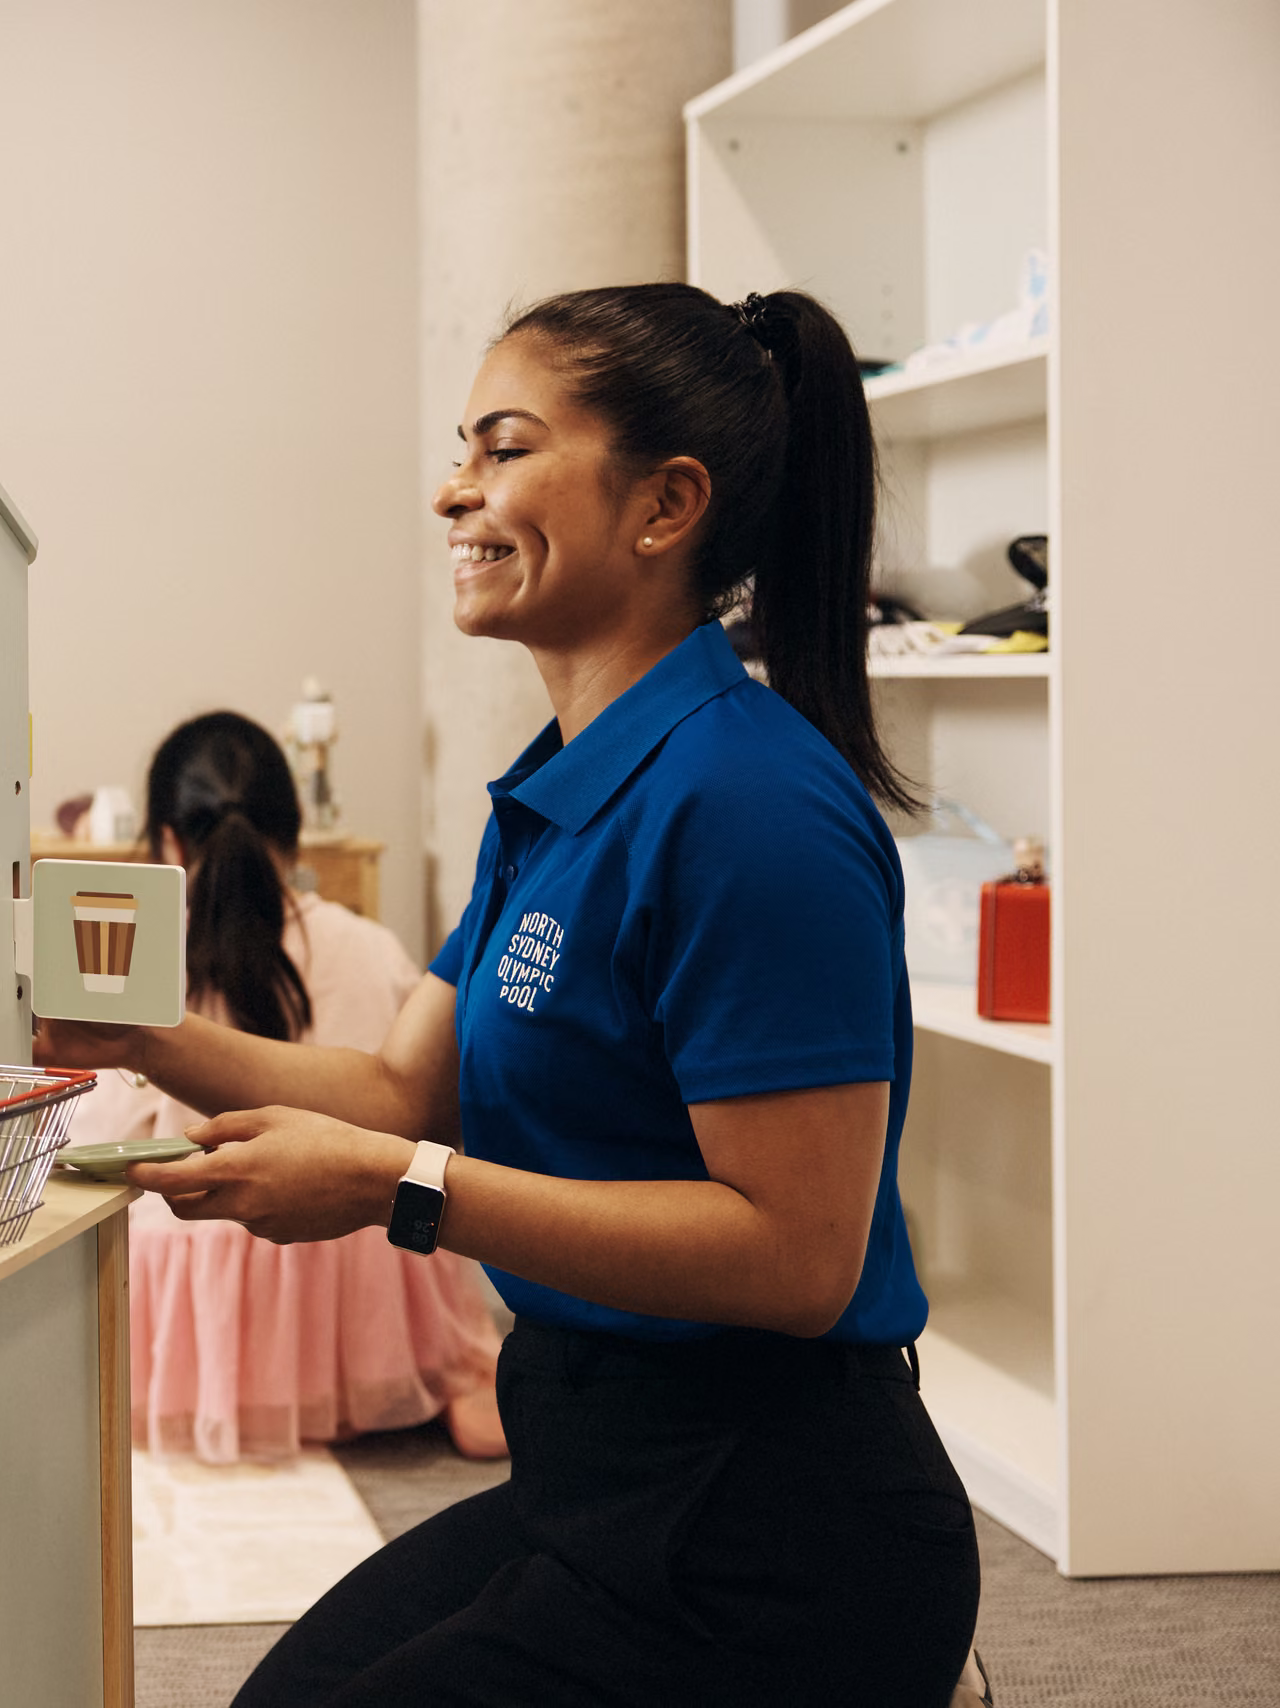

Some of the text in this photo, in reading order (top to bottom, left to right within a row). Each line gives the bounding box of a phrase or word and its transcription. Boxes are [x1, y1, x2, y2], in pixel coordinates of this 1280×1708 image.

[518, 912, 564, 948] NORTH
[508, 934, 560, 970] SYDNEY
[498, 955, 554, 992] OLYMPIC
[499, 985, 538, 1012] POOL
